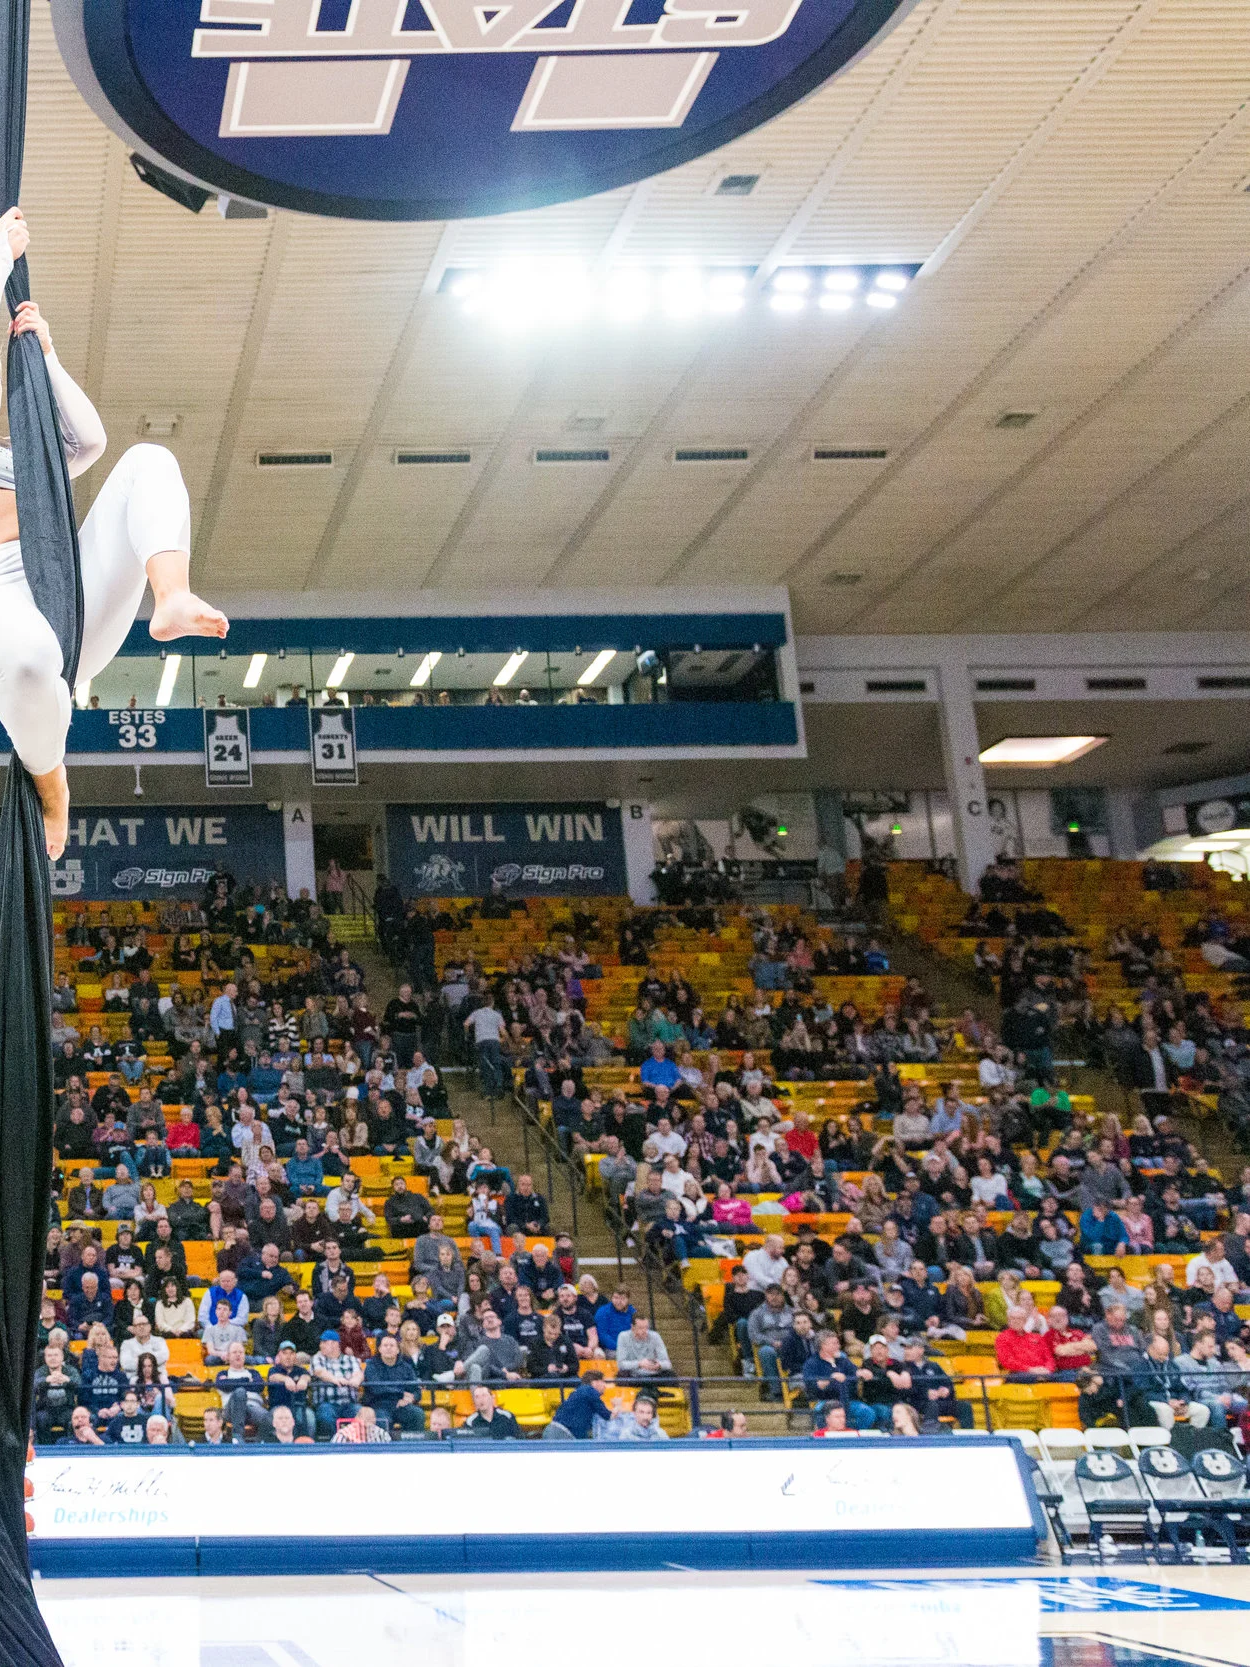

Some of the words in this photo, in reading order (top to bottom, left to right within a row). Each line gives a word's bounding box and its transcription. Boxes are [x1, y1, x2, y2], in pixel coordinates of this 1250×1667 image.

[108, 710, 166, 724] ESTES
[118, 724, 157, 748] 33
[214, 743, 242, 761] 24
[322, 743, 346, 759] 31
[291, 808, 305, 823] A
[631, 805, 642, 819] B
[968, 801, 981, 816] C
[66, 818, 144, 846] HAT
[165, 817, 228, 846] WE
[410, 814, 505, 842] WILL
[525, 813, 603, 841] WIN
[145, 869, 190, 887] Sign
[190, 868, 216, 883] Pr
[521, 865, 568, 884] Sign
[568, 864, 605, 880] Pro
[53, 1507, 169, 1526] Dealerships
